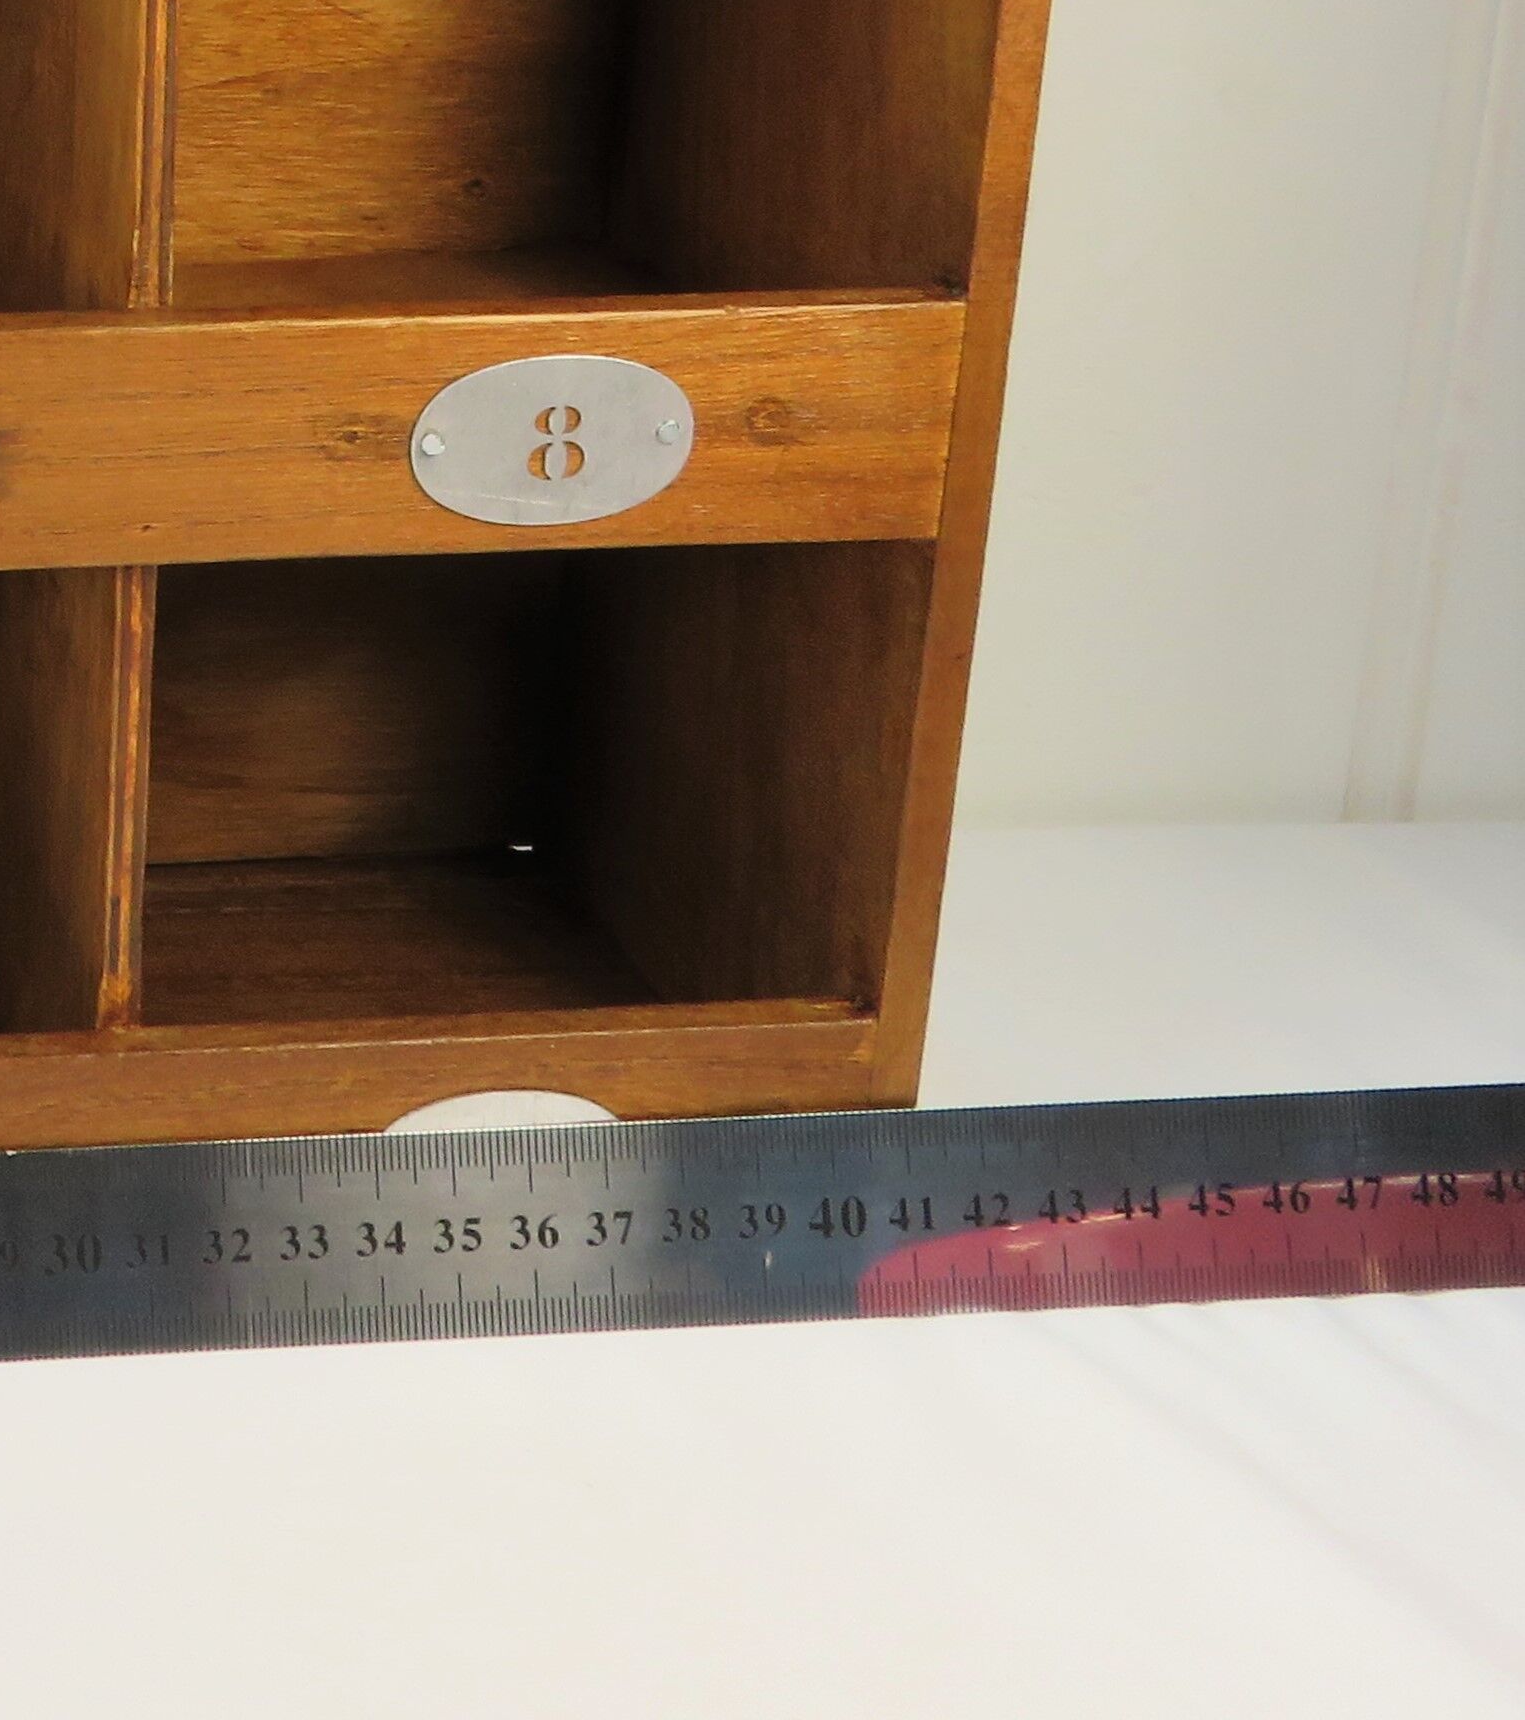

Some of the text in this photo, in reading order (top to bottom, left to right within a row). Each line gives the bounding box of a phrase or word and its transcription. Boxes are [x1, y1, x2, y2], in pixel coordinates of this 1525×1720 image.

[526, 405, 585, 481] 8
[43, 1232, 104, 1275] 30
[124, 1230, 171, 1268] 31
[201, 1227, 252, 1266] 32
[279, 1222, 330, 1261] 33
[356, 1219, 406, 1257] 34
[432, 1216, 483, 1254] 35
[508, 1213, 560, 1251] 36
[585, 1209, 635, 1247] 37
[662, 1205, 712, 1243] 38
[738, 1201, 787, 1240] 39
[808, 1195, 868, 1239] 40
[887, 1194, 936, 1232] 41
[962, 1192, 1012, 1228] 42
[1037, 1188, 1088, 1225] 43
[1112, 1185, 1162, 1220] 44
[1187, 1181, 1237, 1217] 45
[1261, 1179, 1311, 1215] 46
[1336, 1176, 1382, 1210] 47
[1410, 1172, 1459, 1207] 48
